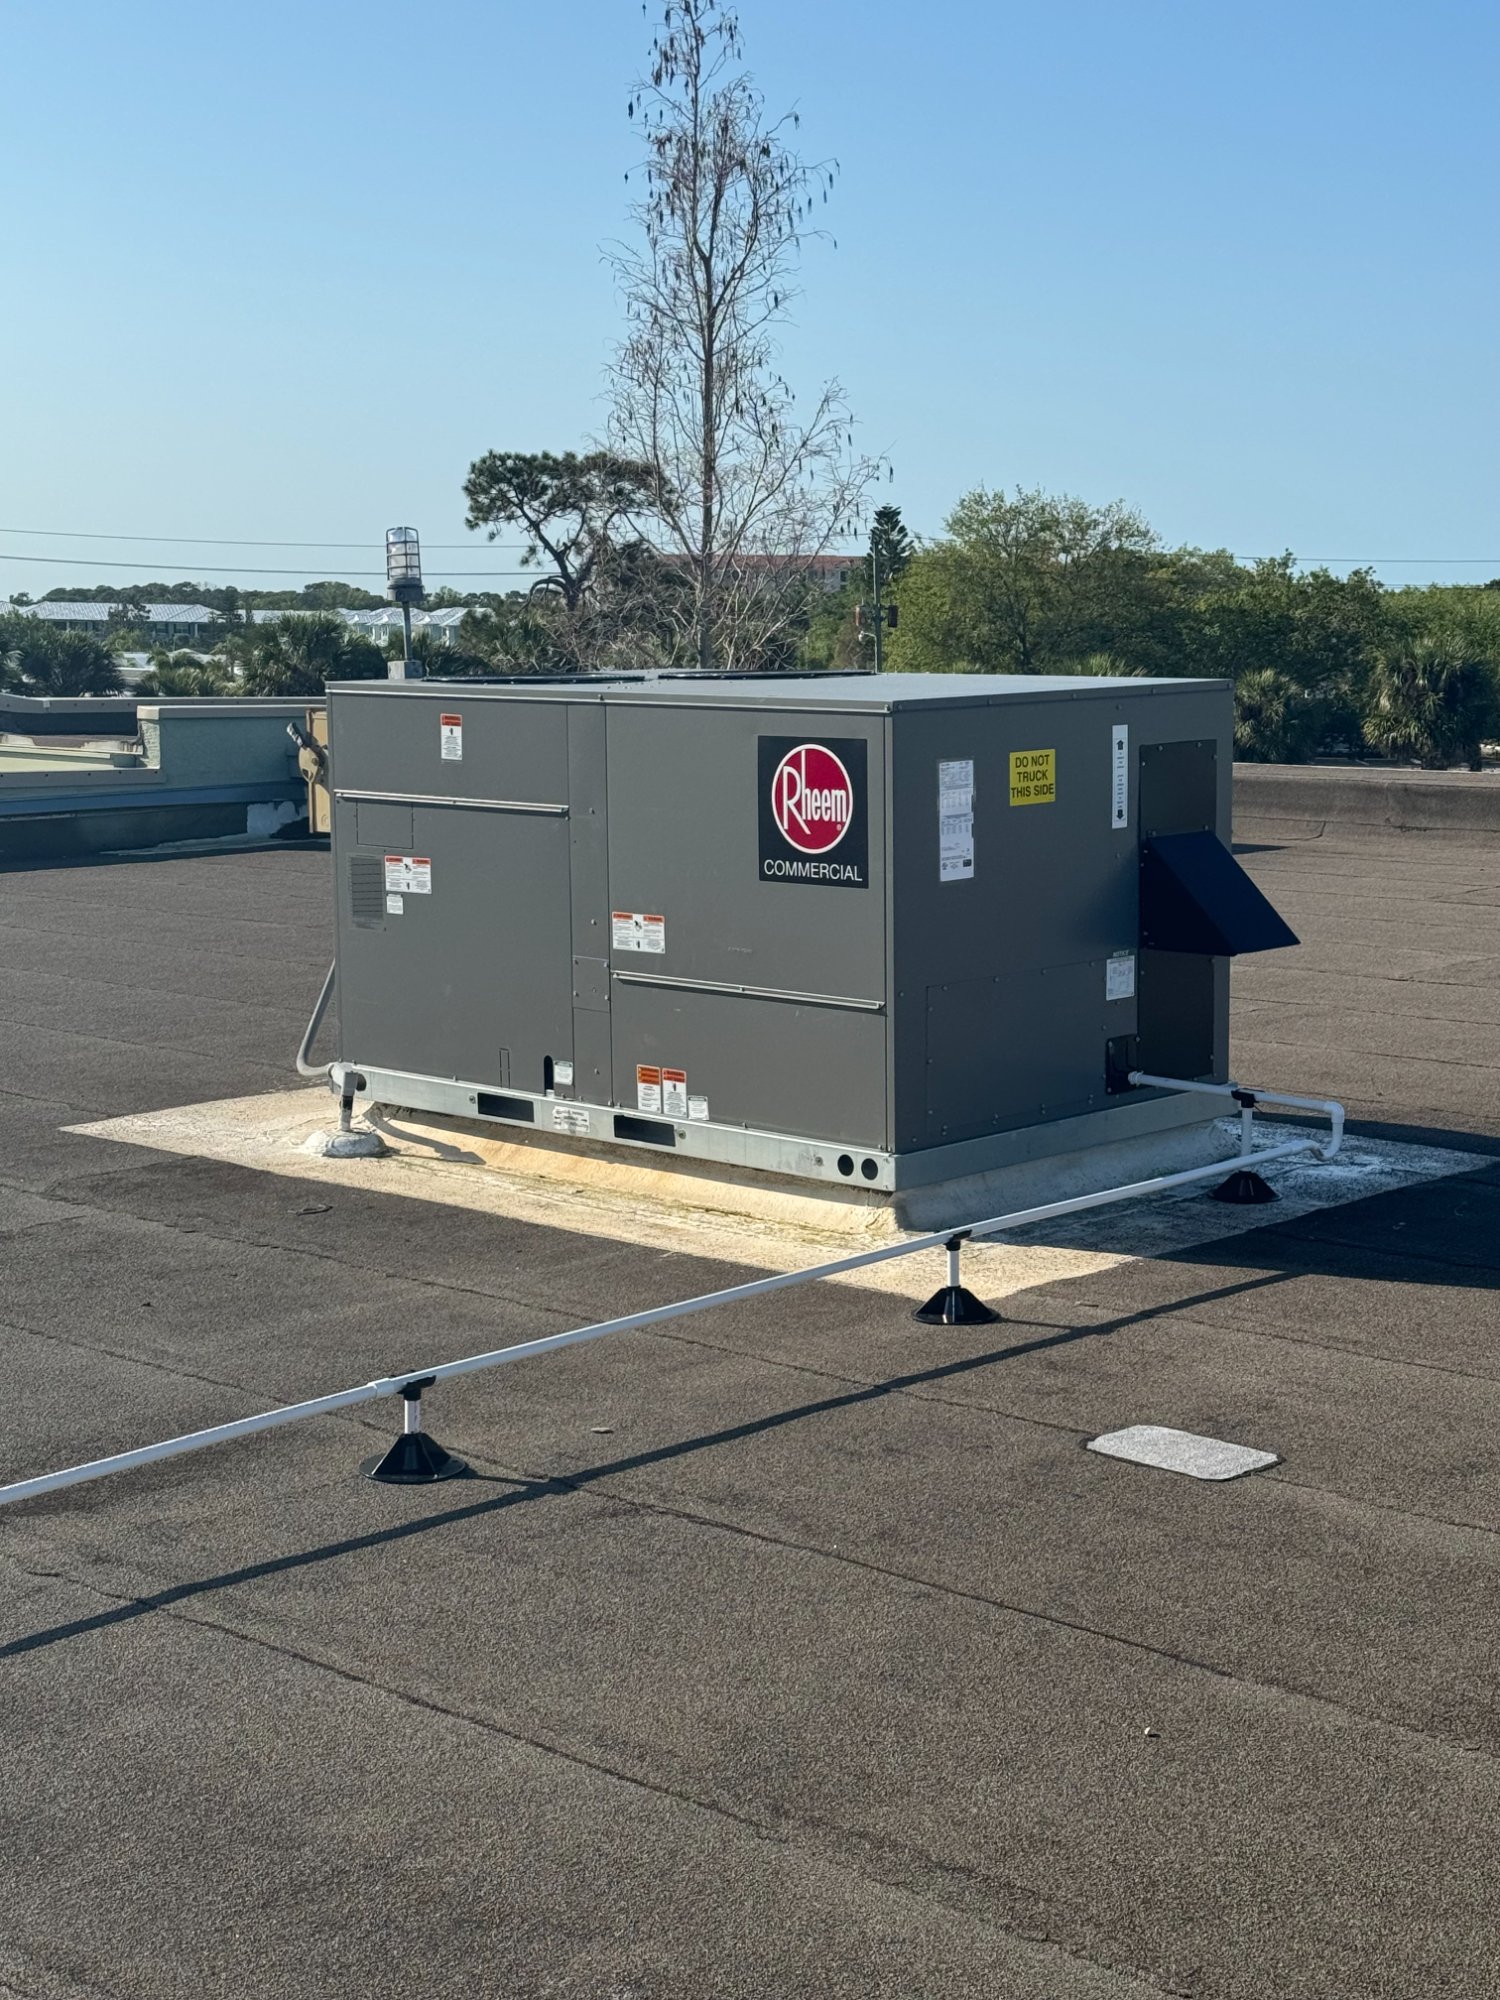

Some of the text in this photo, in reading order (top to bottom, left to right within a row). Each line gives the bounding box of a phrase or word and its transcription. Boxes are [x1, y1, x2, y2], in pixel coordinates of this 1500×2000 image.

[1015, 754, 1050, 768] DO NOT
[1017, 769, 1048, 783] TRUCK
[783, 749, 847, 835] Rheem
[1011, 783, 1054, 798] THIS SIDE
[764, 859, 863, 881] COMMERCIAL
